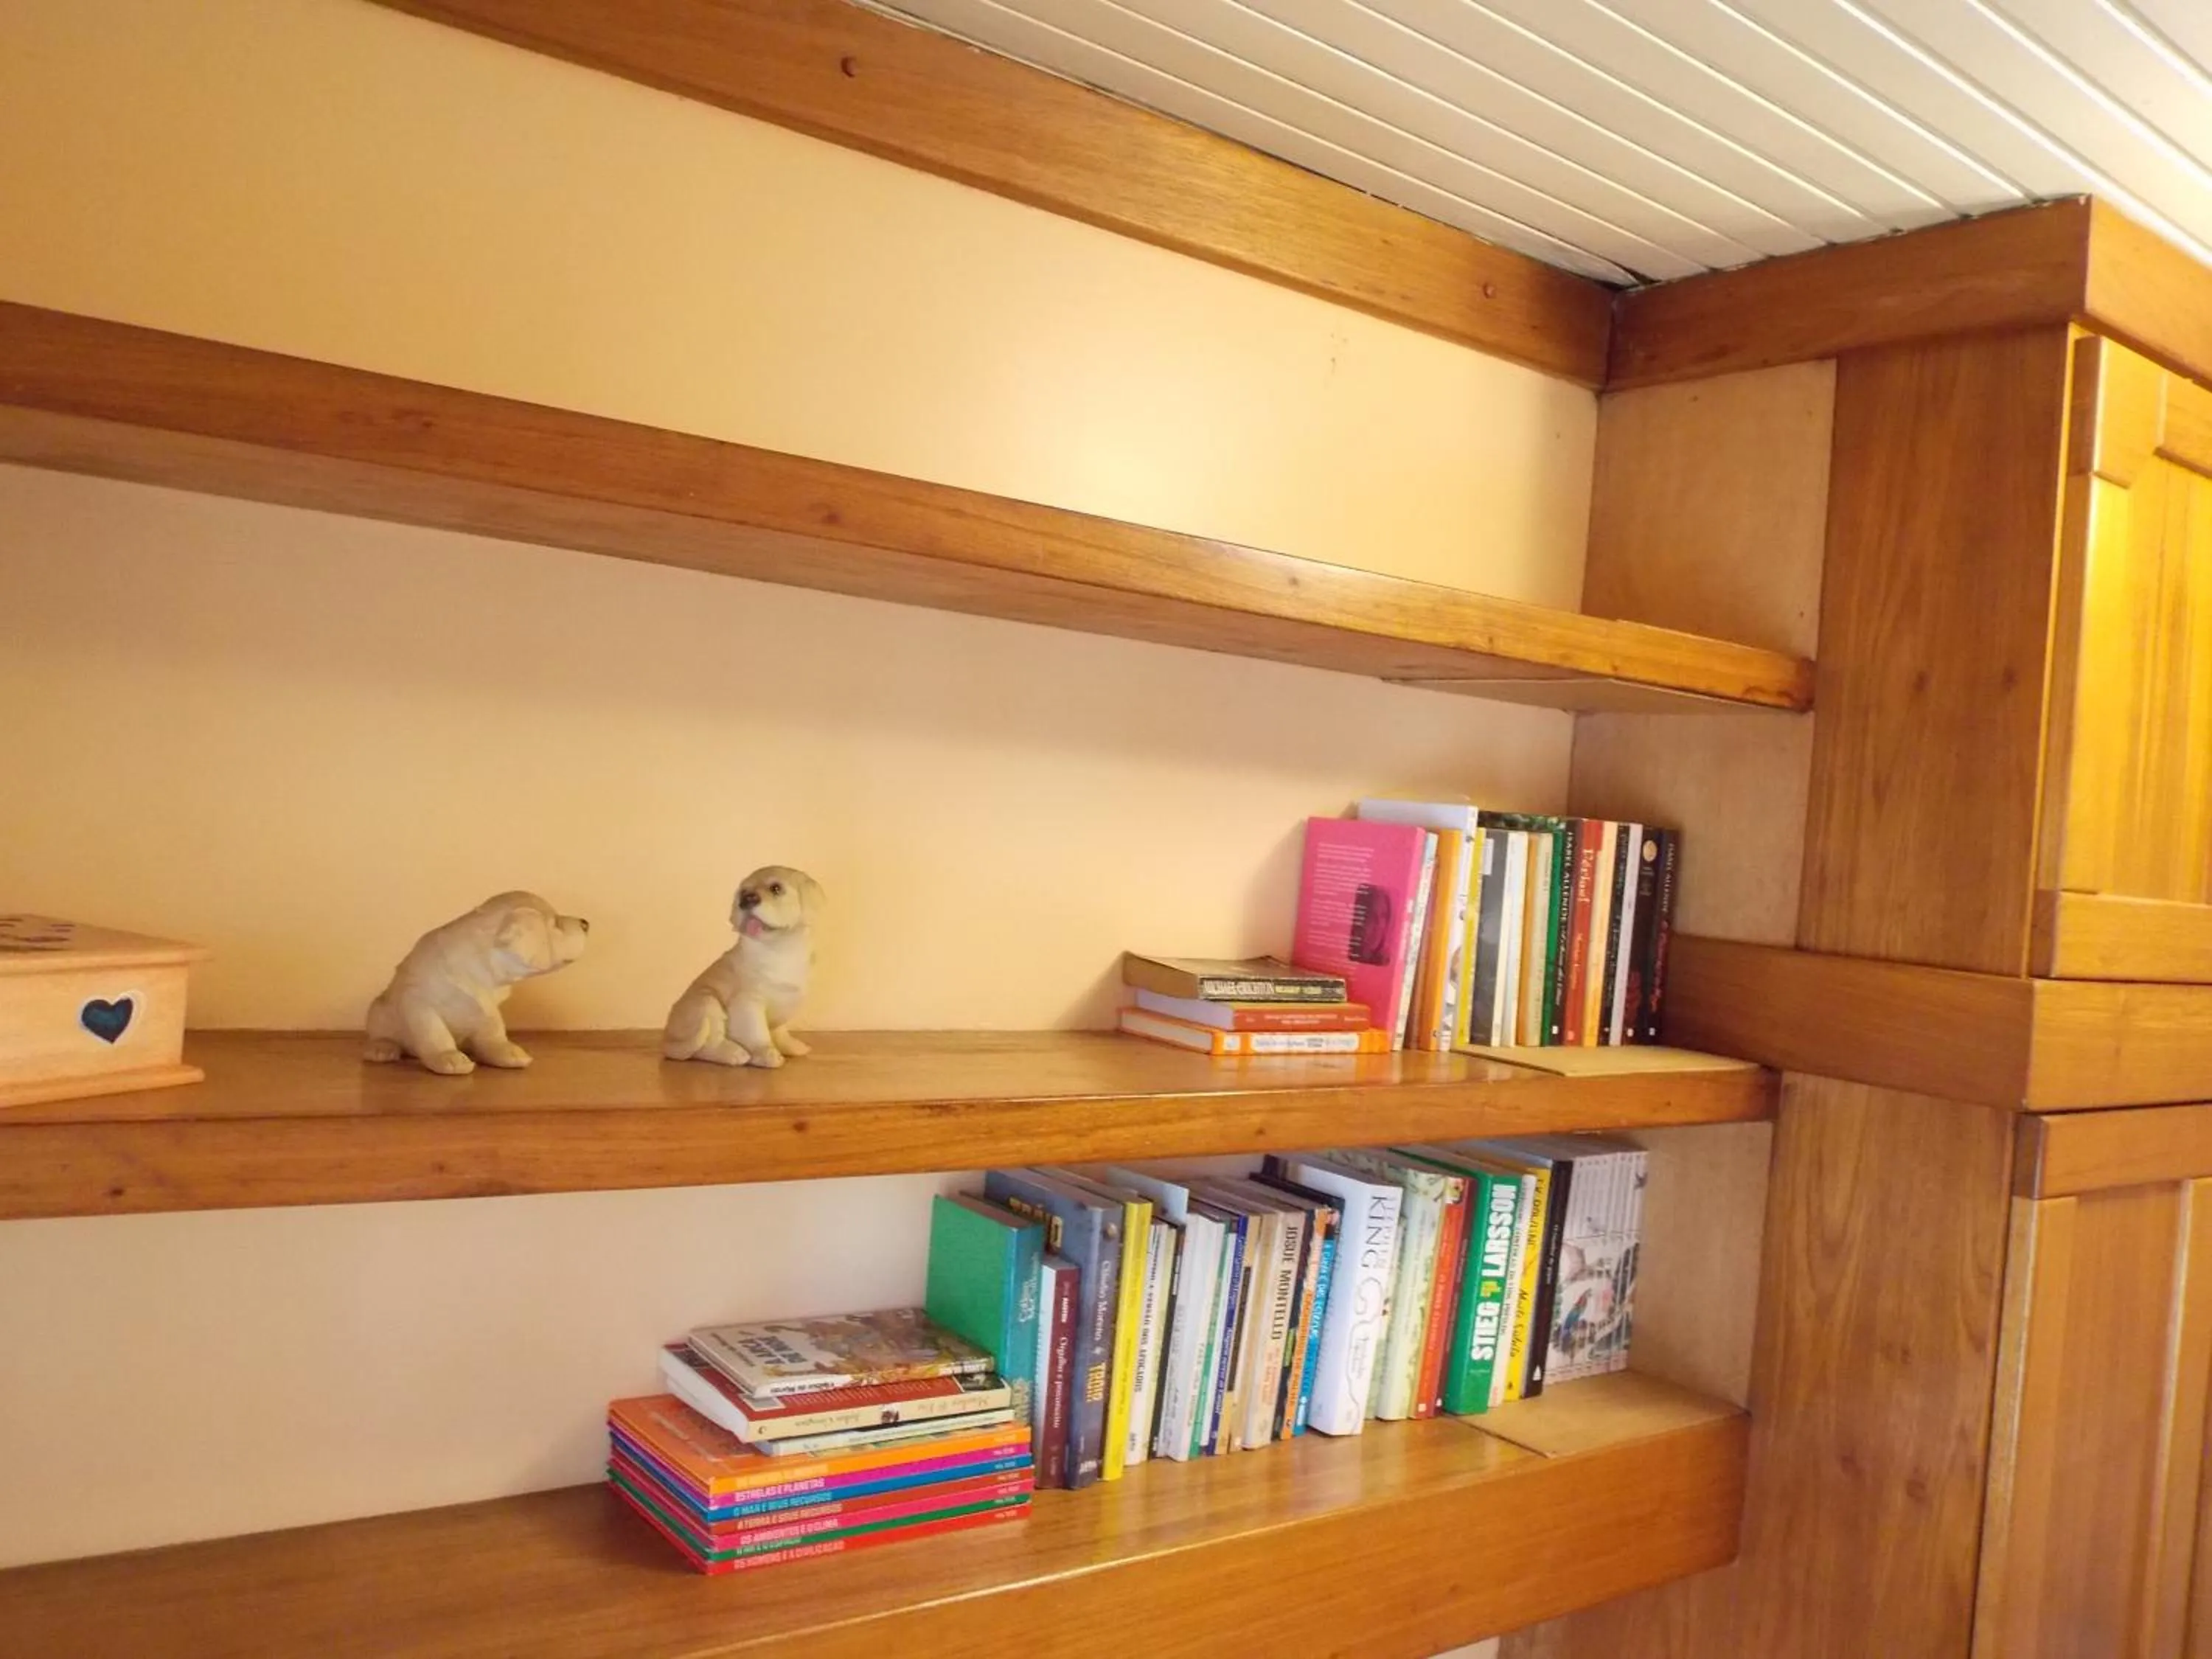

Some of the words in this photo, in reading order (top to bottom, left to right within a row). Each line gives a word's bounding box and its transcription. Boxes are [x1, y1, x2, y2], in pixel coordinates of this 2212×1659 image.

[1361, 1195, 1388, 1269] KING
[1481, 1183, 1517, 1278] LARSSON
[1093, 1300, 1109, 1342] Moreno
[1271, 1270, 1292, 1340] MONTELLO
[1471, 1301, 1500, 1361] STIEG
[1514, 1288, 1529, 1321] Morte
[1054, 1336, 1069, 1373] Orgulho
